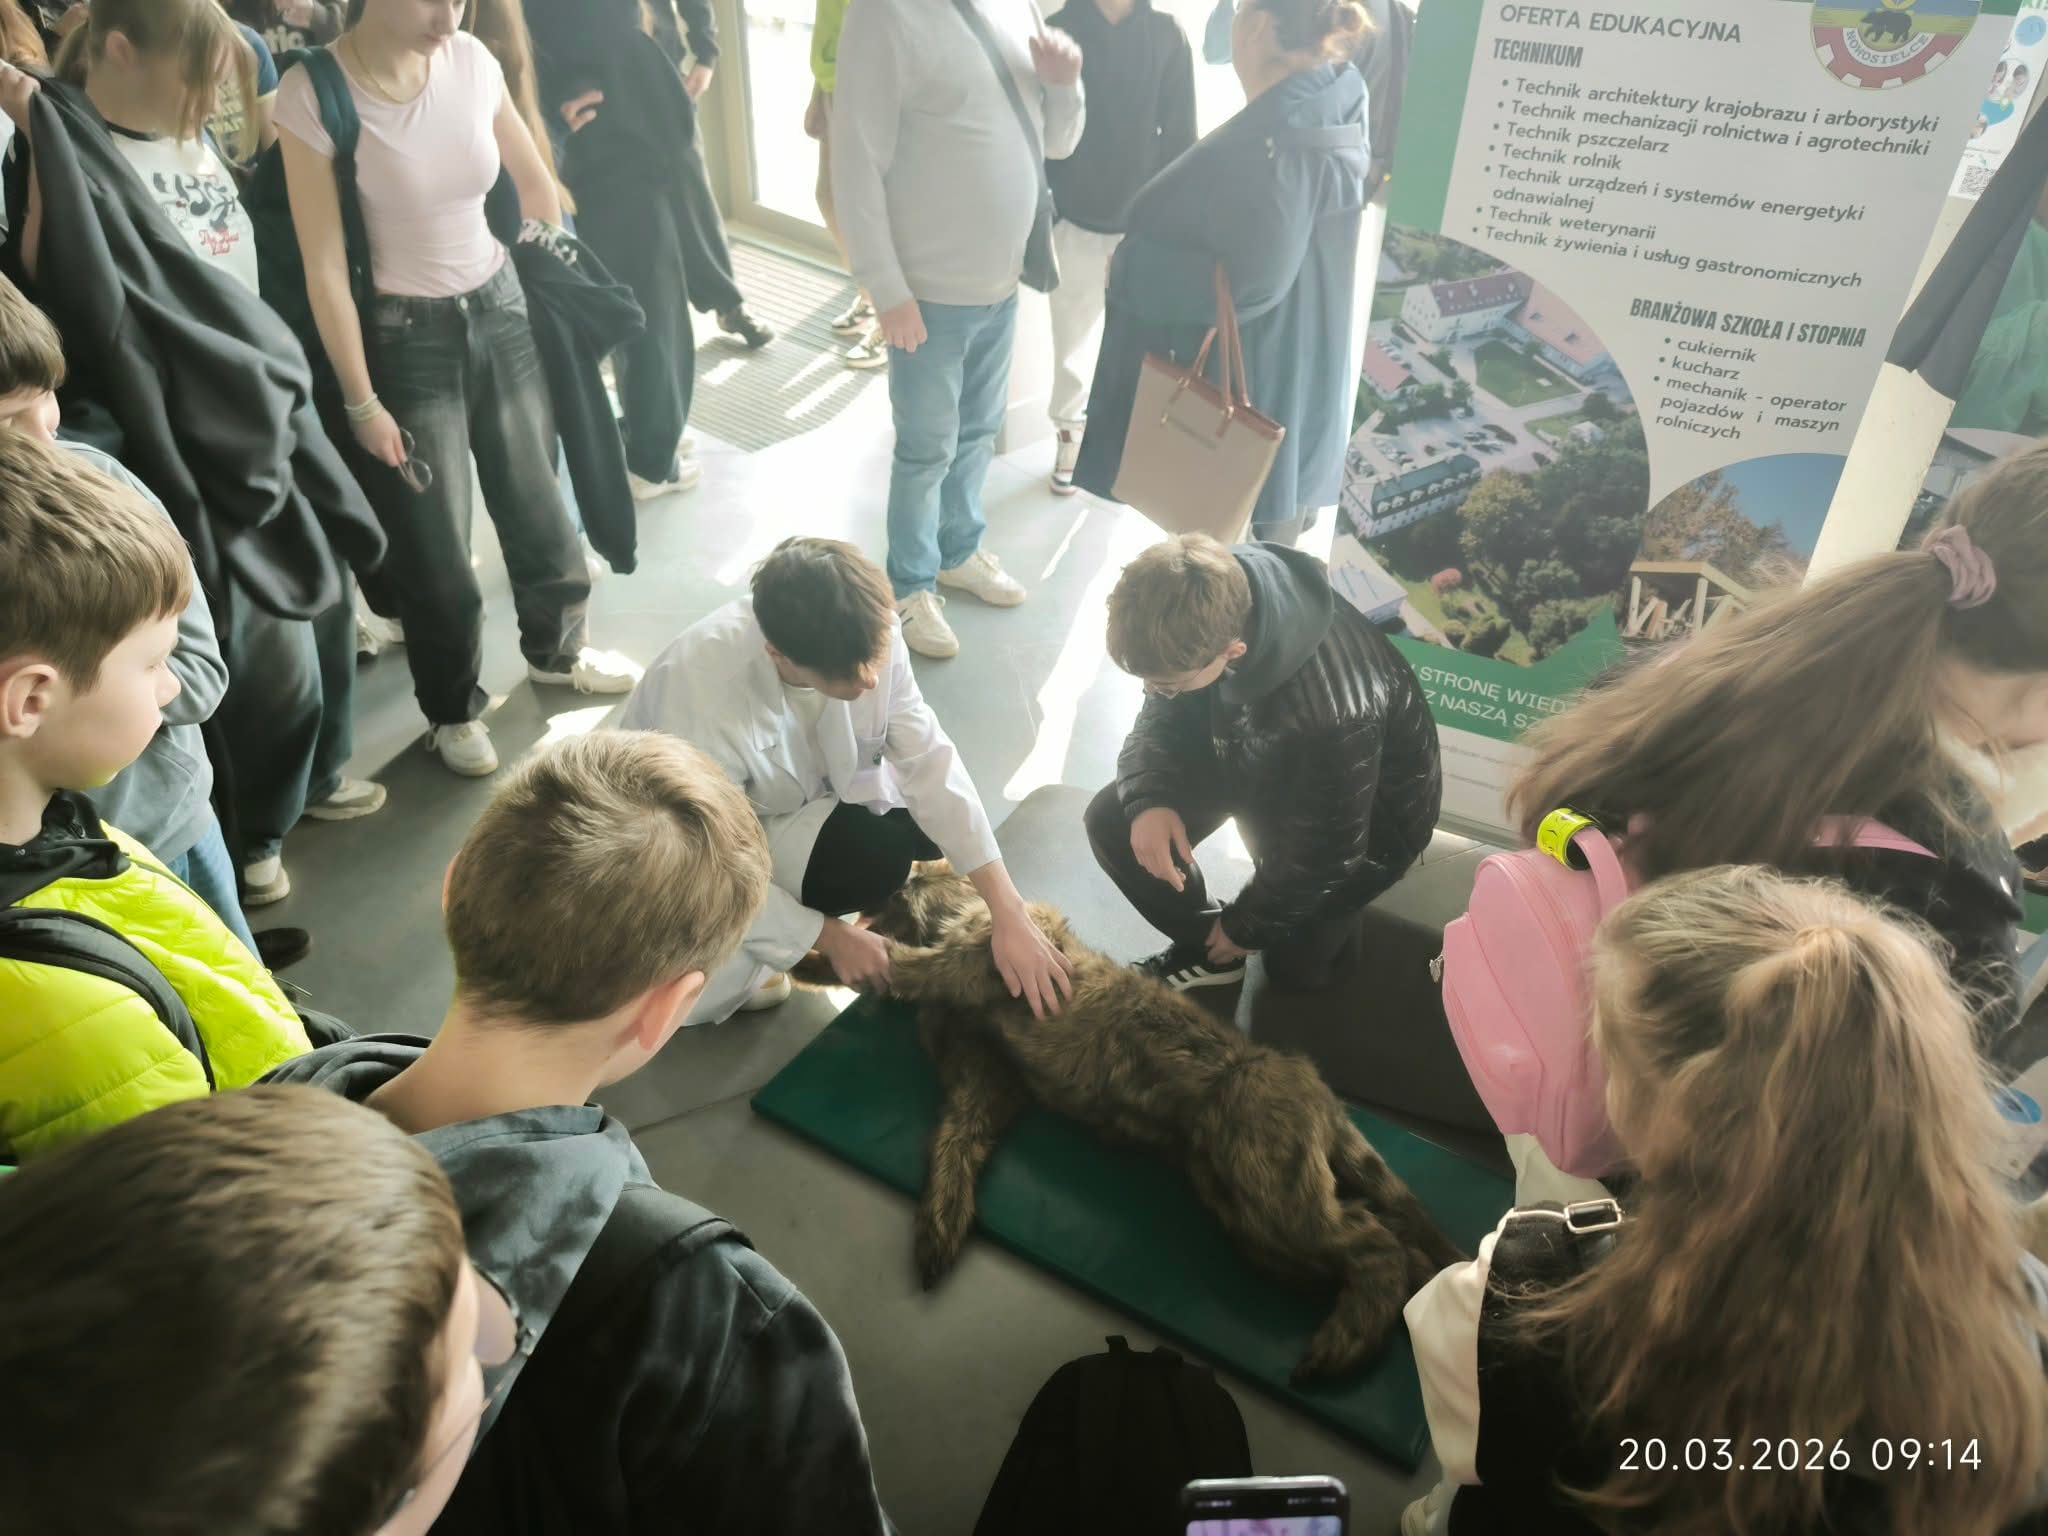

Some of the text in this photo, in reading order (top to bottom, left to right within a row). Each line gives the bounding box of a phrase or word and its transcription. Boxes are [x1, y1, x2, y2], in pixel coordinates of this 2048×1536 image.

[1500, 4, 1741, 42] OFERTA EDUKACYJNA
[1493, 38, 1584, 67] TECHNIKUM
[1516, 77, 1940, 134] Technik architektury krajobrazu i arborystyki
[1507, 122, 1670, 153] Technik pszczelarz
[1511, 100, 1931, 156] Technik mechanizacji rolnictwa i agrotechniki
[1503, 143, 1622, 170] Technik rolnik
[1493, 187, 1595, 213] odnawialnej
[1499, 164, 1866, 222] Technik urządzeń i systemów energetyki
[1490, 206, 1657, 239] Technik weterynarii
[1486, 226, 1862, 288] Technik żywienia i usług gastronomicznych
[1630, 298, 1867, 347] BRANŻOWA SZKOŁA I STOPNIA
[1672, 356, 1740, 380] kucharz
[1677, 339, 1758, 363] cukiernik
[1666, 377, 1748, 401] mechanik
[1770, 395, 1847, 412] operator
[1656, 413, 1741, 439] rolniczych
[1660, 396, 1840, 433] pojazdów i maszyn
[1419, 666, 1568, 714] STRONĘ WIED
[1440, 694, 1509, 727] NASZĄ
[1513, 713, 1541, 731] SZ
